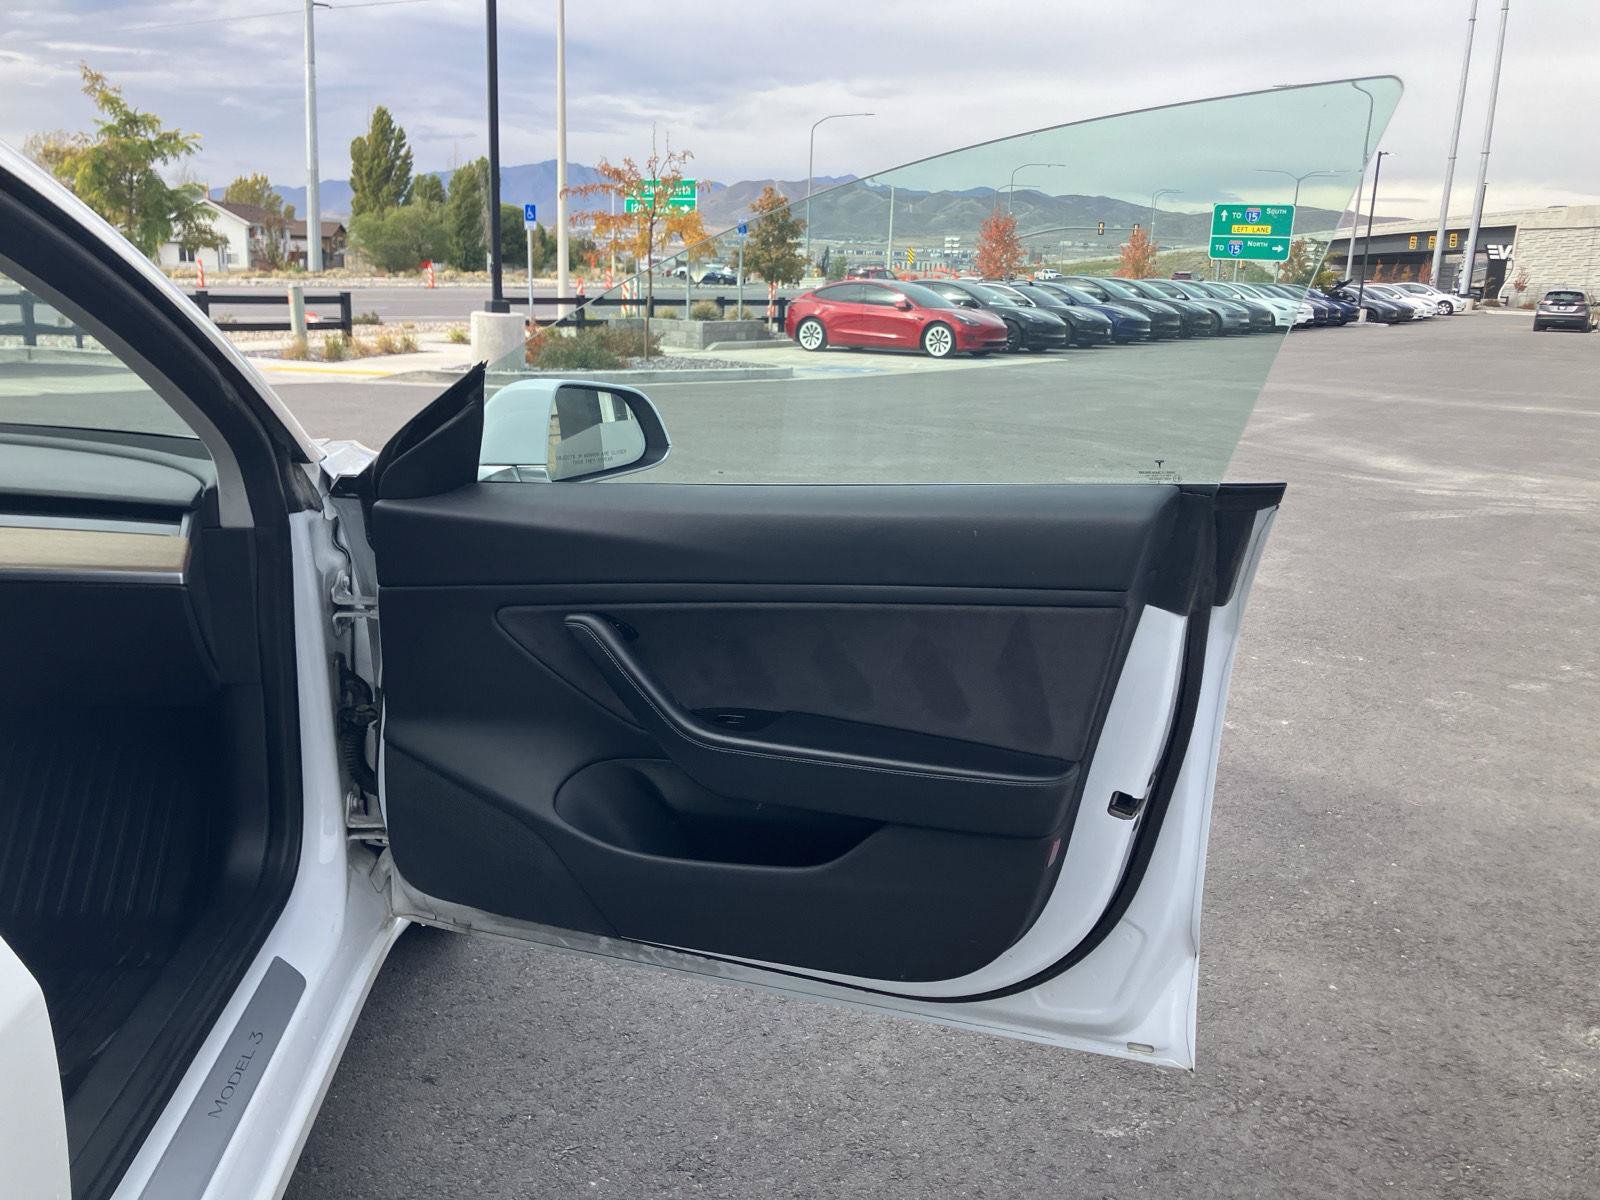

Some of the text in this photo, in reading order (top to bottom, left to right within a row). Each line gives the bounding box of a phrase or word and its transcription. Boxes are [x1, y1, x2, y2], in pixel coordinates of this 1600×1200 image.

[1248, 212, 1258, 222] 15
[1230, 245, 1240, 254] 15
[207, 1031, 264, 1119] MODEL 3
